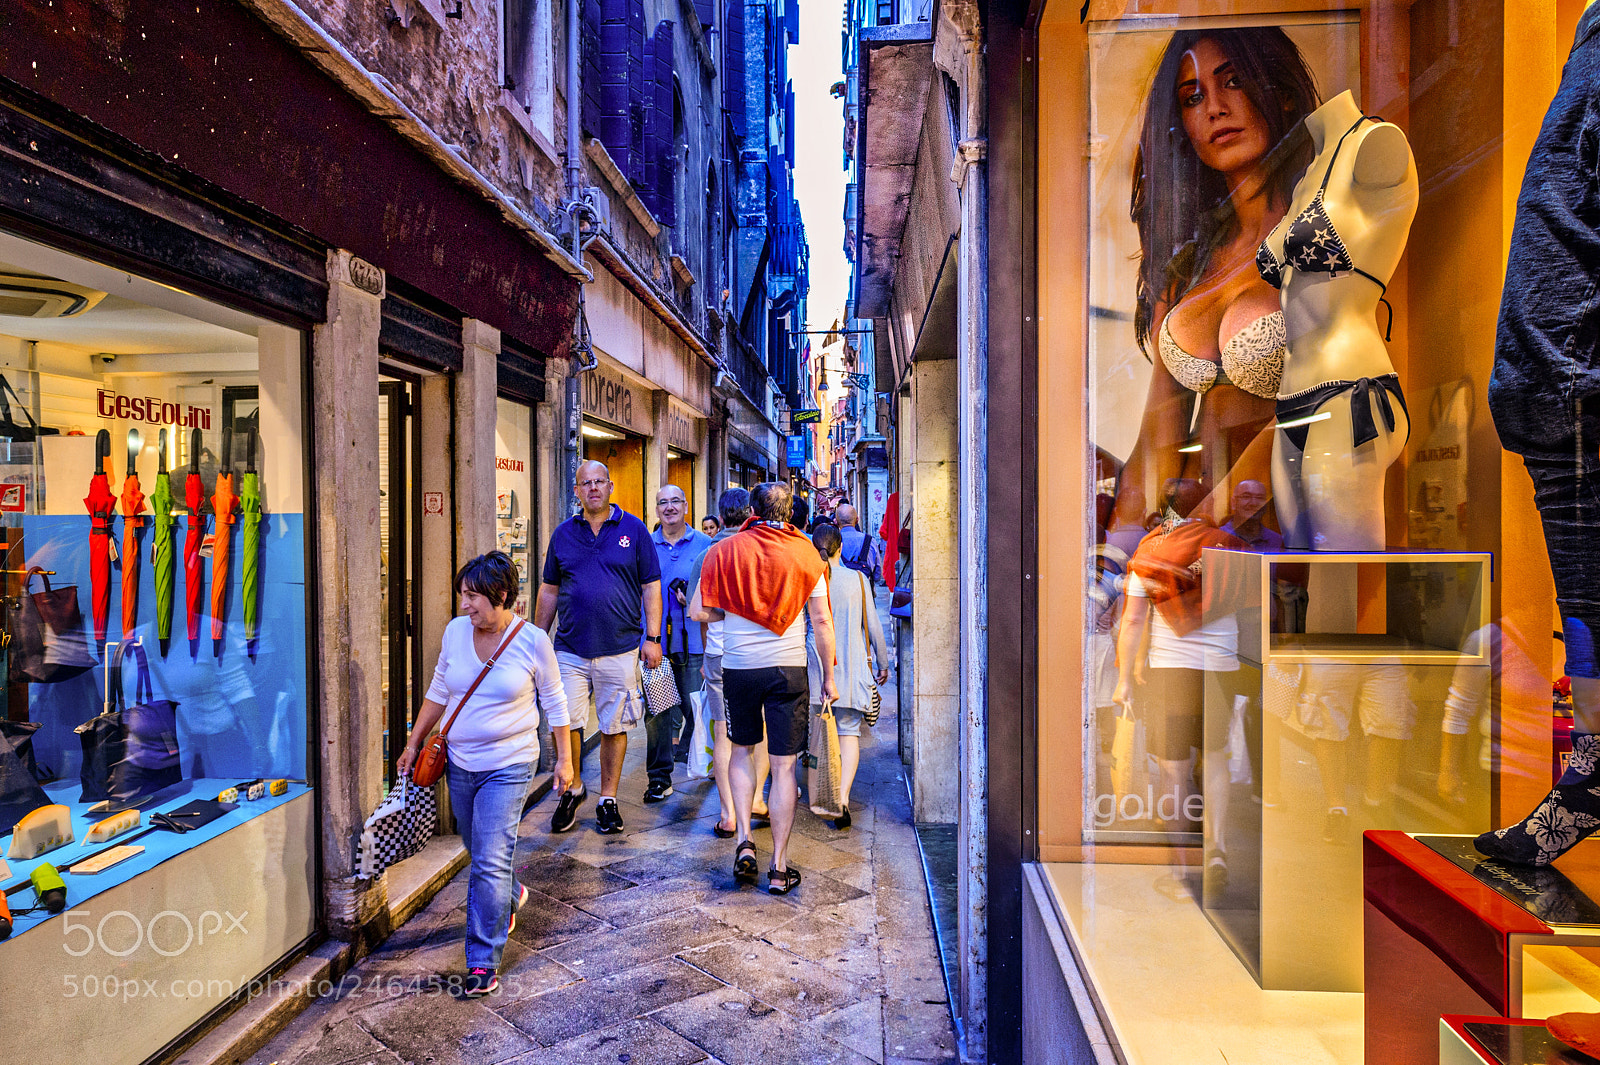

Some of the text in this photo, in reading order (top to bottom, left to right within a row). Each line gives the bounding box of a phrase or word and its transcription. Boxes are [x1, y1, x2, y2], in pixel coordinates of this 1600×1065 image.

[96, 388, 211, 430] testolini
[582, 370, 632, 426] ibreria
[789, 436, 803, 452] T
[1094, 784, 1204, 827] golde
